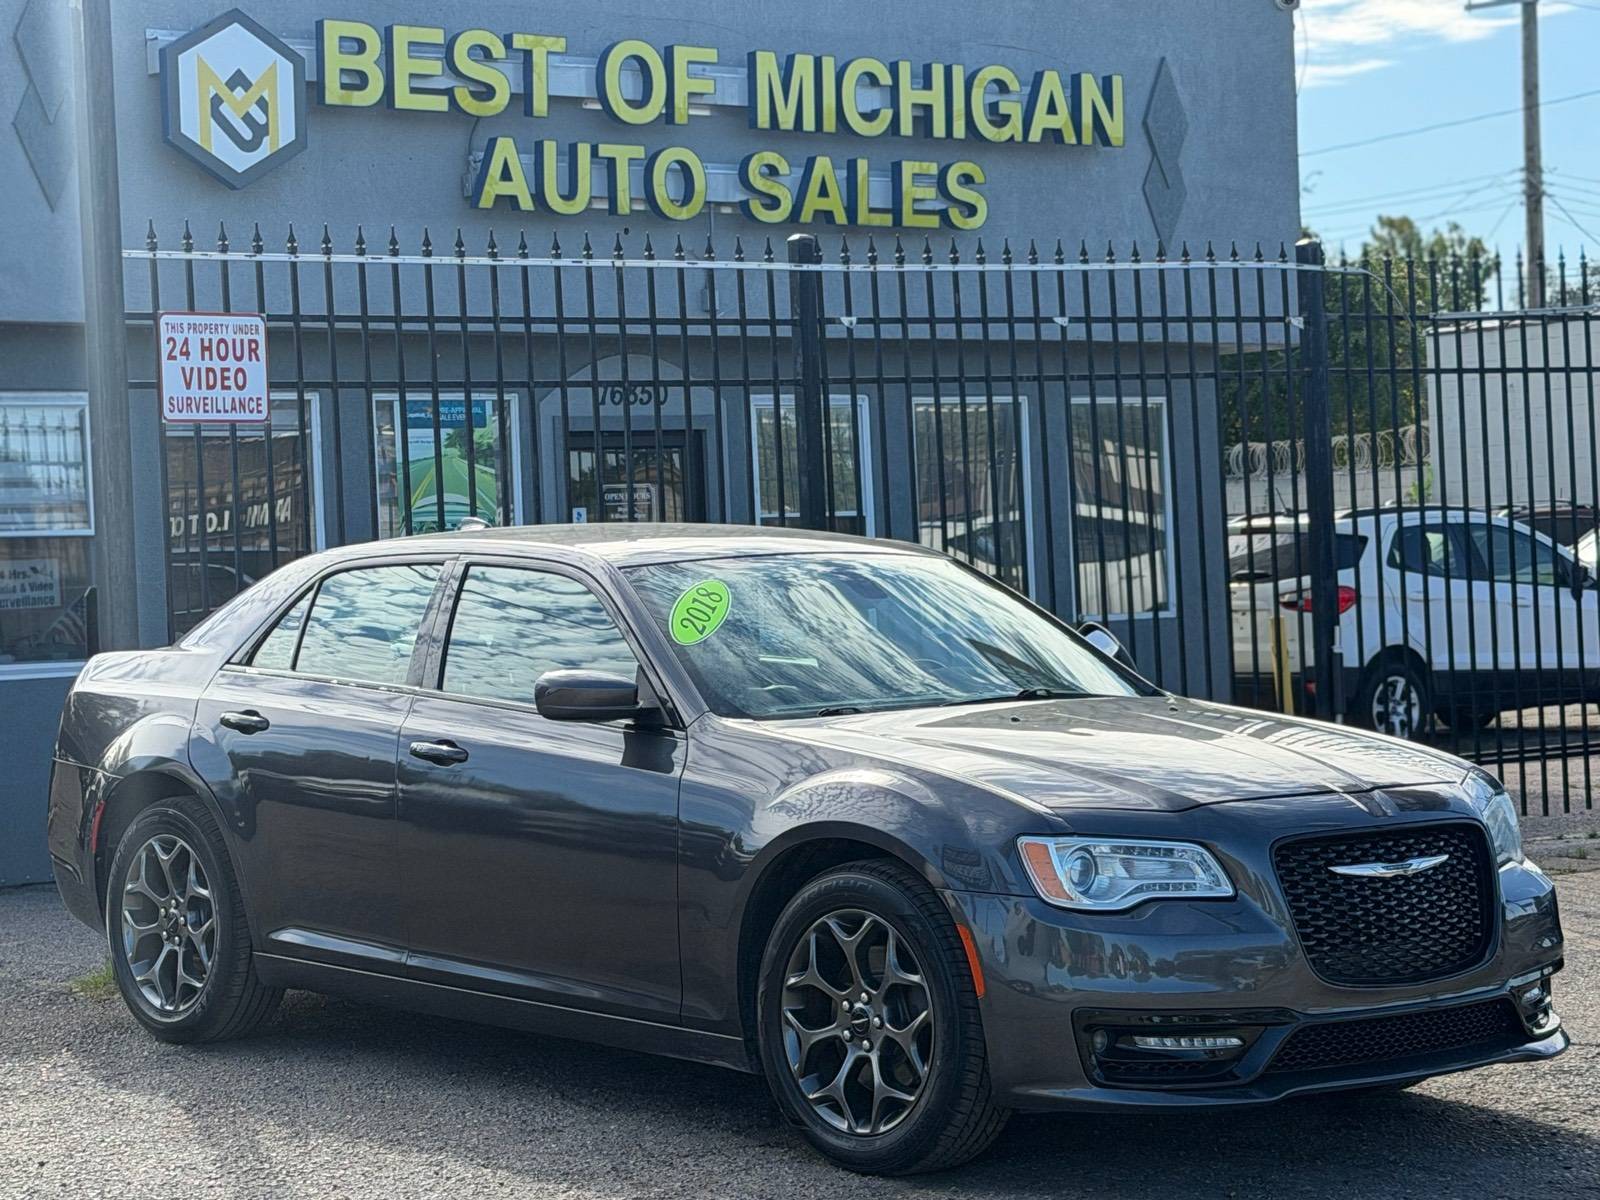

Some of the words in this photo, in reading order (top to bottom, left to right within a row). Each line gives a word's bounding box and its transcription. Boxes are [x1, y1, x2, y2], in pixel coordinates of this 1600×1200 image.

[317, 18, 568, 118] BEST
[598, 39, 719, 125] OF
[748, 50, 1124, 147] MICHIGAN
[473, 136, 707, 221] AUTO
[739, 151, 988, 230] SALES
[165, 322, 185, 334] THIS
[187, 323, 230, 335] PROPERTY
[232, 324, 260, 336] UNDER
[166, 337, 190, 361] 24
[200, 337, 260, 362] HOUR
[181, 366, 247, 391] VIDEO
[168, 396, 263, 414] SURVEILLANCE
[680, 587, 723, 636] 2018
